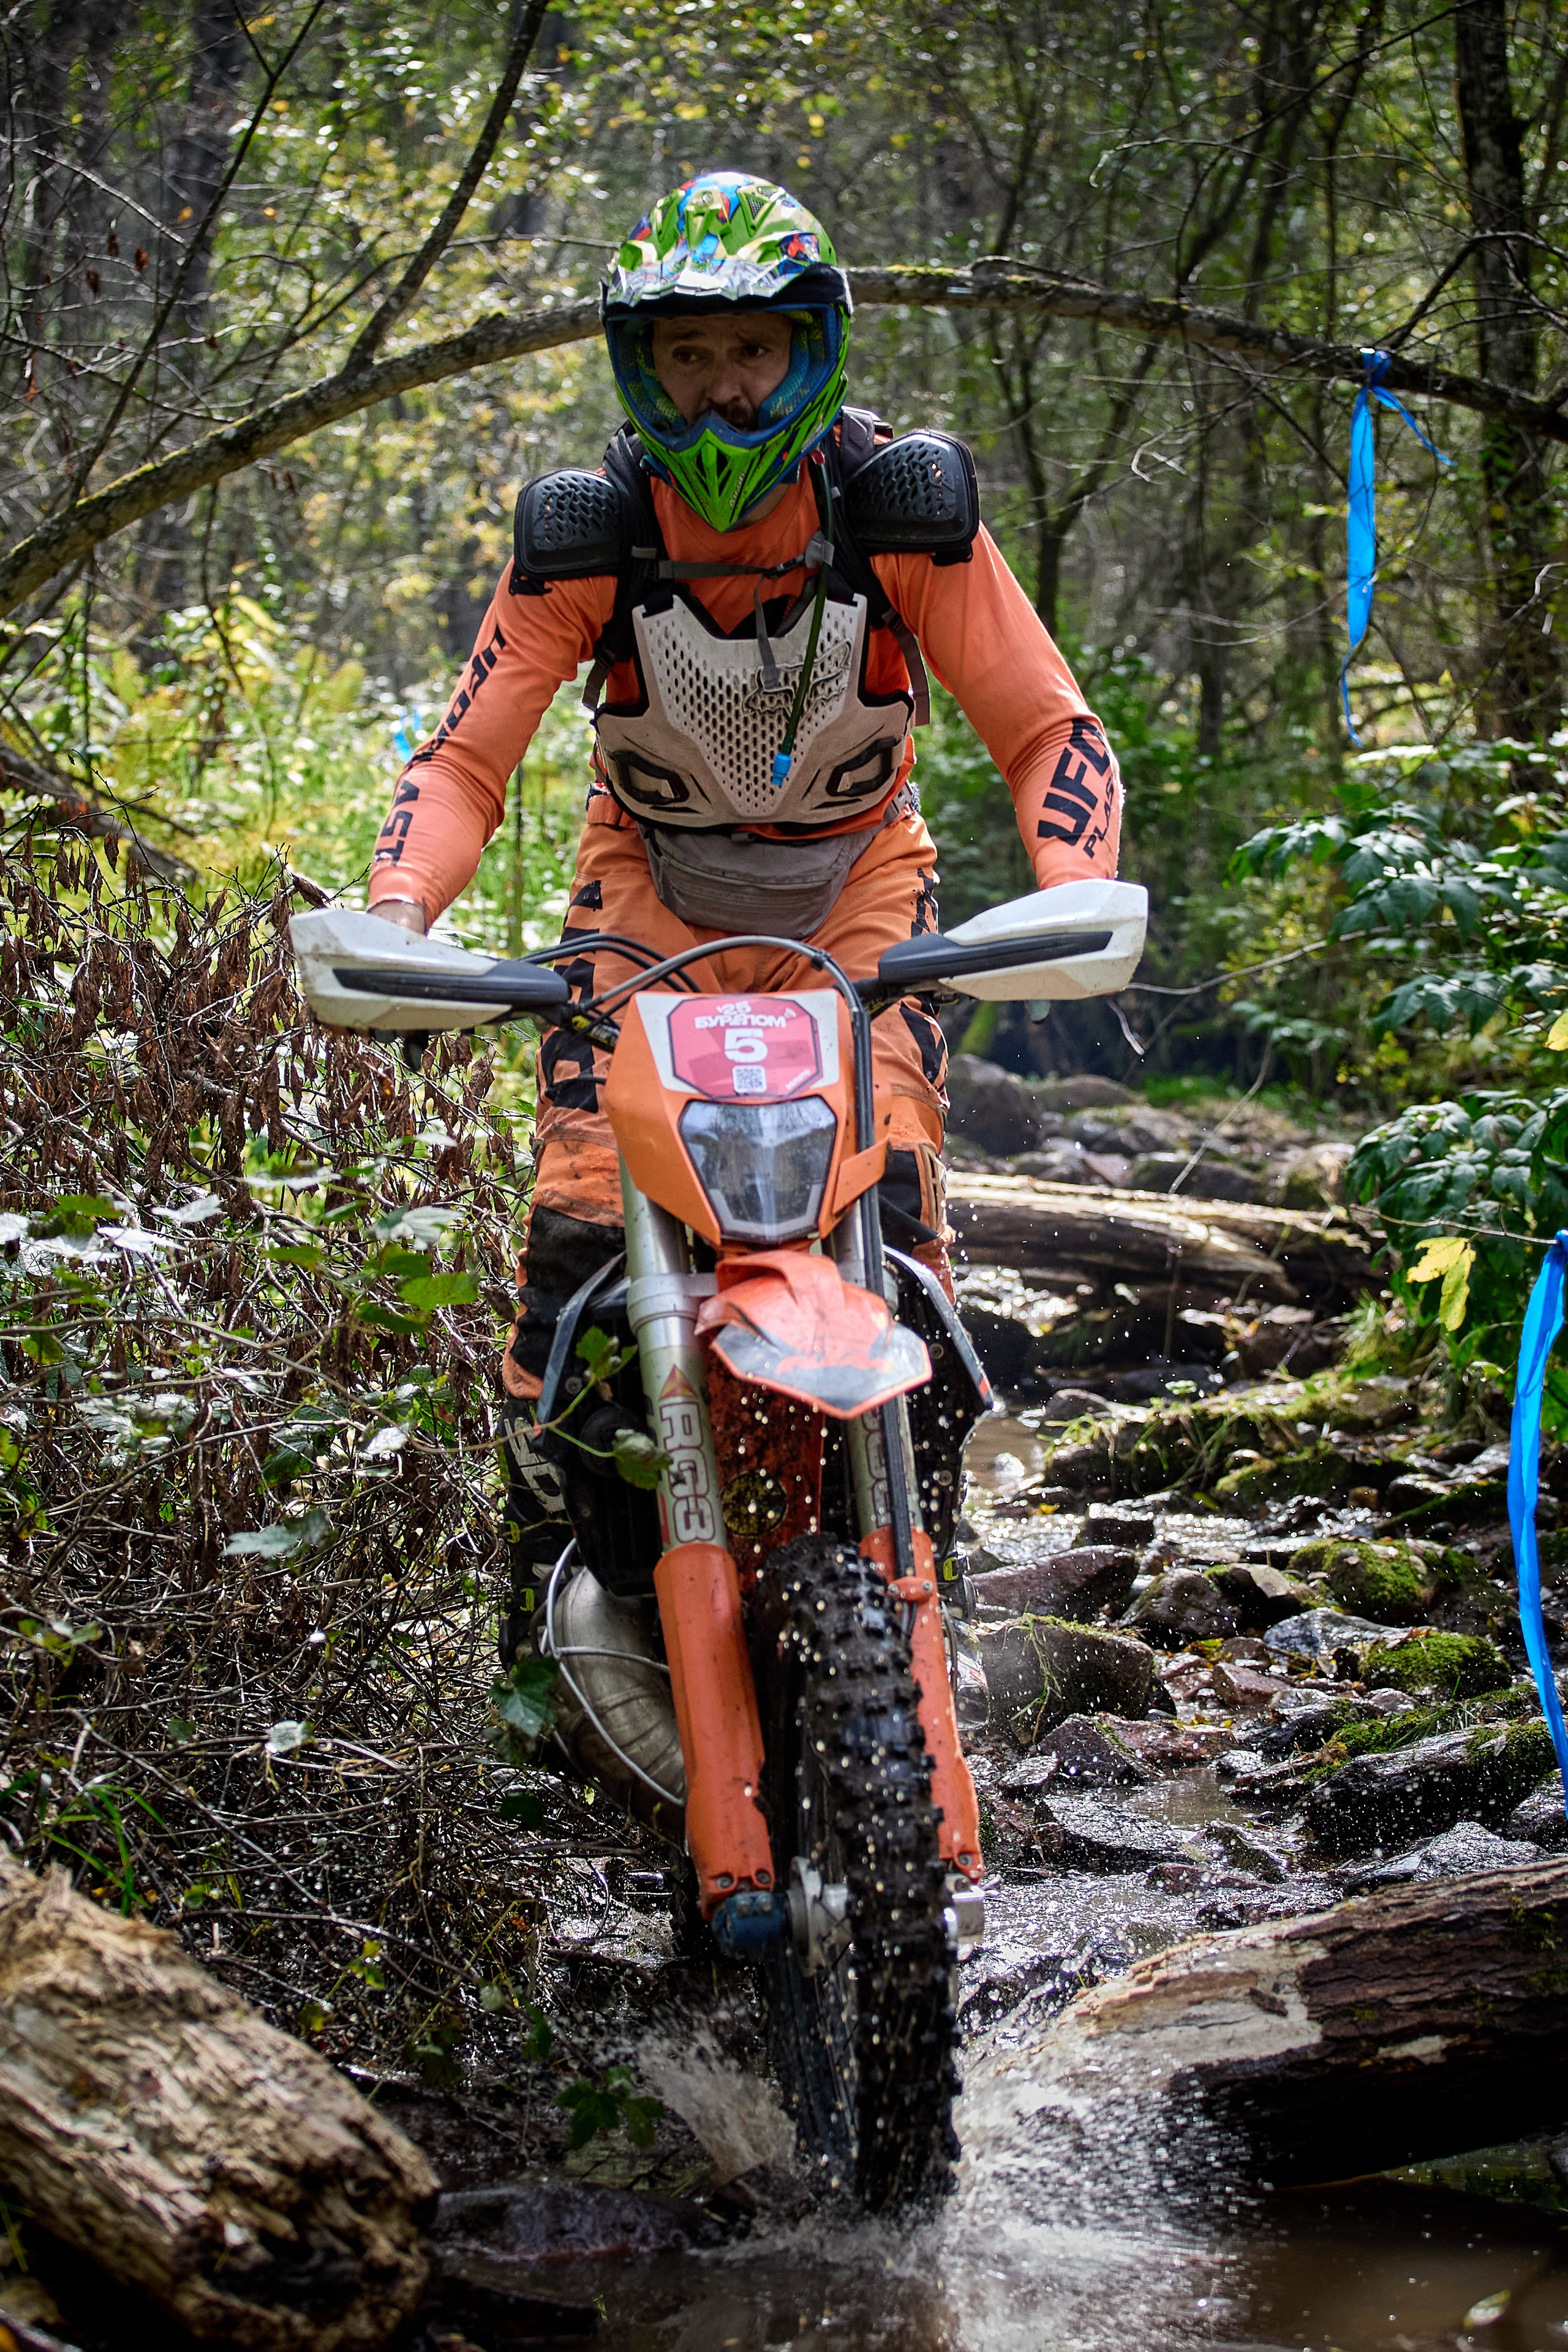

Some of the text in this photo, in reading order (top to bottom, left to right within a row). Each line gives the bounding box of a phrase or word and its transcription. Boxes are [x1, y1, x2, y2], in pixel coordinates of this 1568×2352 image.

[1037, 717, 1110, 845] UFO
[1083, 774, 1114, 859] PLAS
[725, 1028, 768, 1063] 5
